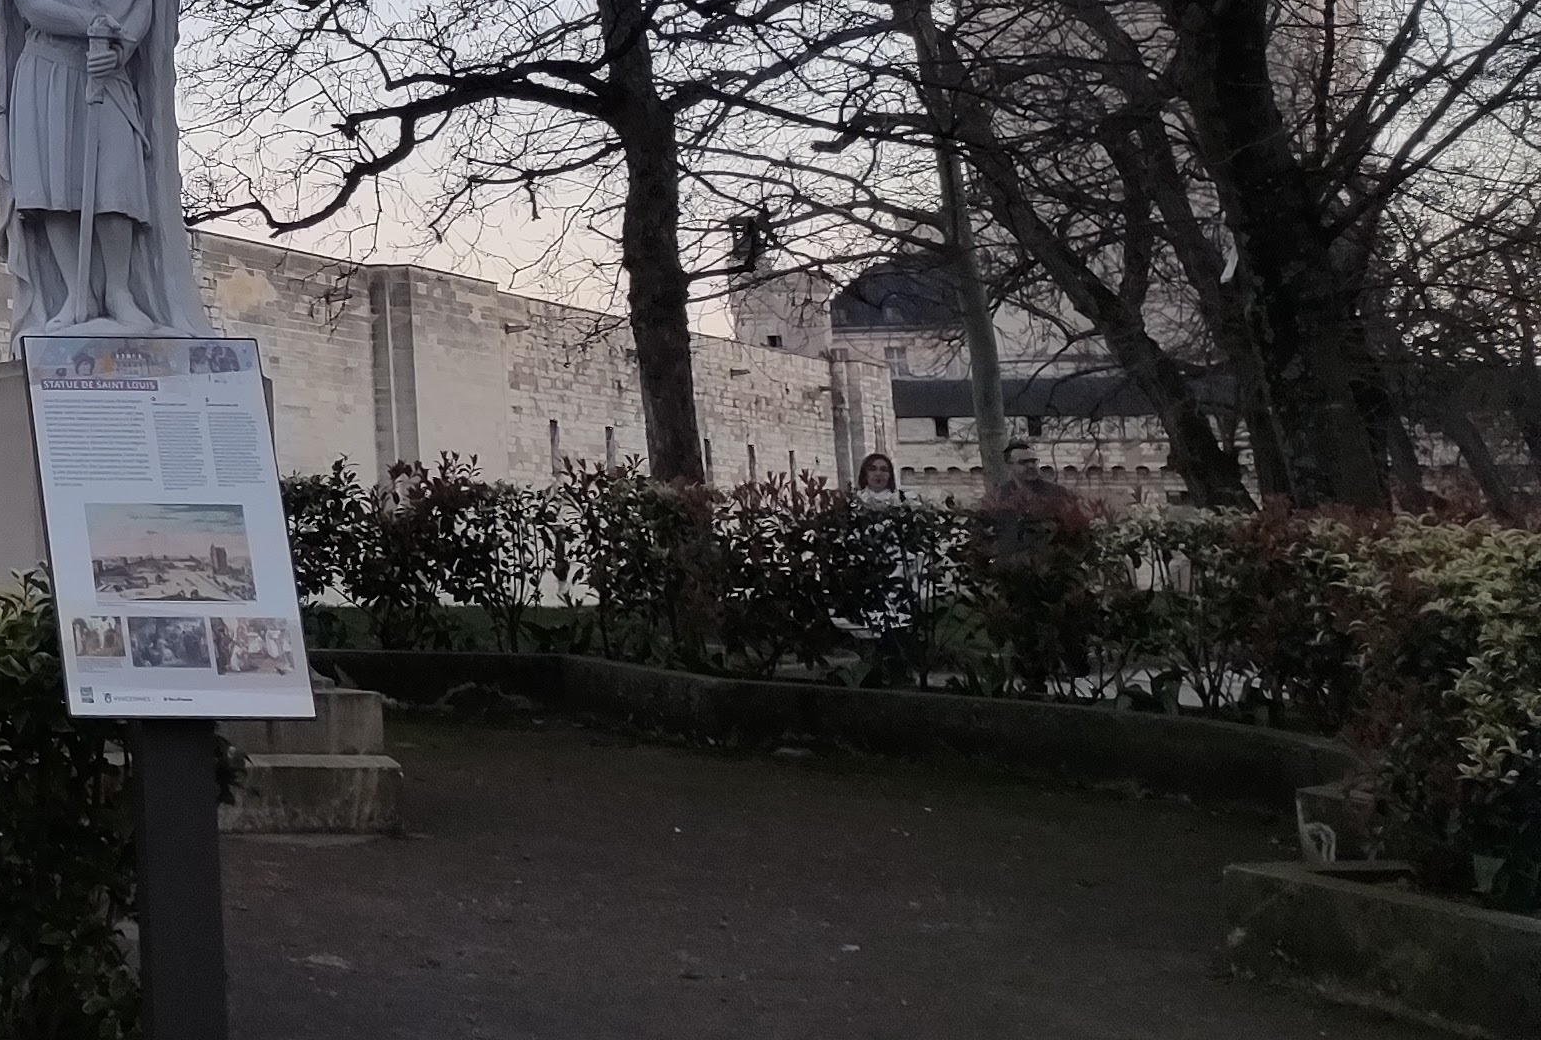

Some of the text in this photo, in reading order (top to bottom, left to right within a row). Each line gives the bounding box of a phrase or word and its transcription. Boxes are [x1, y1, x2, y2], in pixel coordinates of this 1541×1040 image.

[43, 380, 156, 390] STATUE DE SAINT LOUIS
